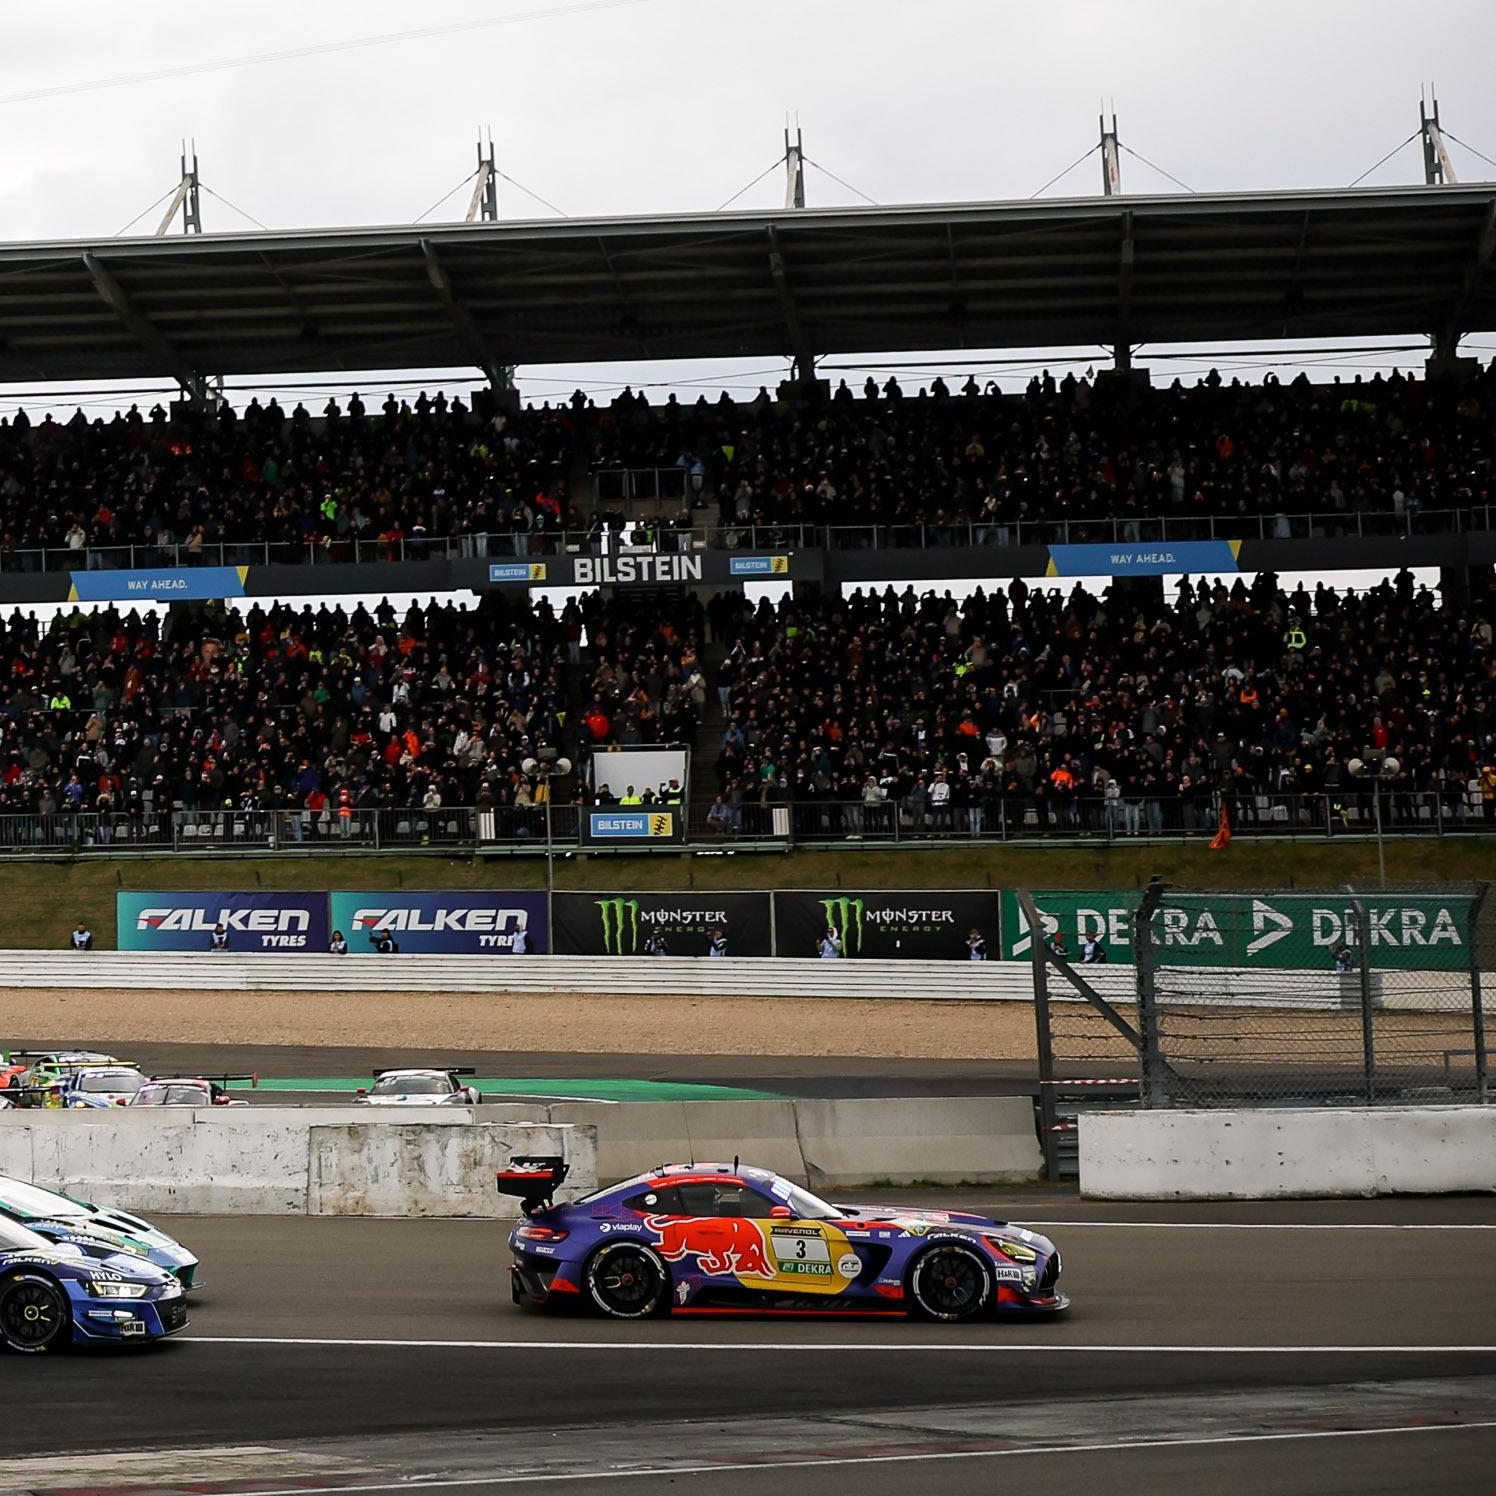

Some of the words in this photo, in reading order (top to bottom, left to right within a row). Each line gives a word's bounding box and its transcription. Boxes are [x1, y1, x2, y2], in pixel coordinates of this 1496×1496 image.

[1110, 554, 1133, 564] WAY
[1136, 553, 1176, 563] AHEAD.
[574, 555, 702, 583] BILSTEIN
[735, 561, 768, 570] BILSTEIN
[494, 568, 527, 577] BILSTEIN
[128, 580, 149, 590] WAY
[151, 579, 189, 589] AHEAD.
[598, 819, 643, 831] BILSTEIN
[136, 908, 311, 931] FALKEN
[351, 908, 528, 931] FALKEN
[640, 908, 728, 924] MONSTER
[866, 908, 955, 924] MONSTER
[261, 935, 307, 948] TYRES
[927, 1232, 977, 1244] FALKEN
[795, 1240, 807, 1259] 3
[797, 1263, 833, 1274] DEKRA
[89, 1270, 123, 1281] HYLO
